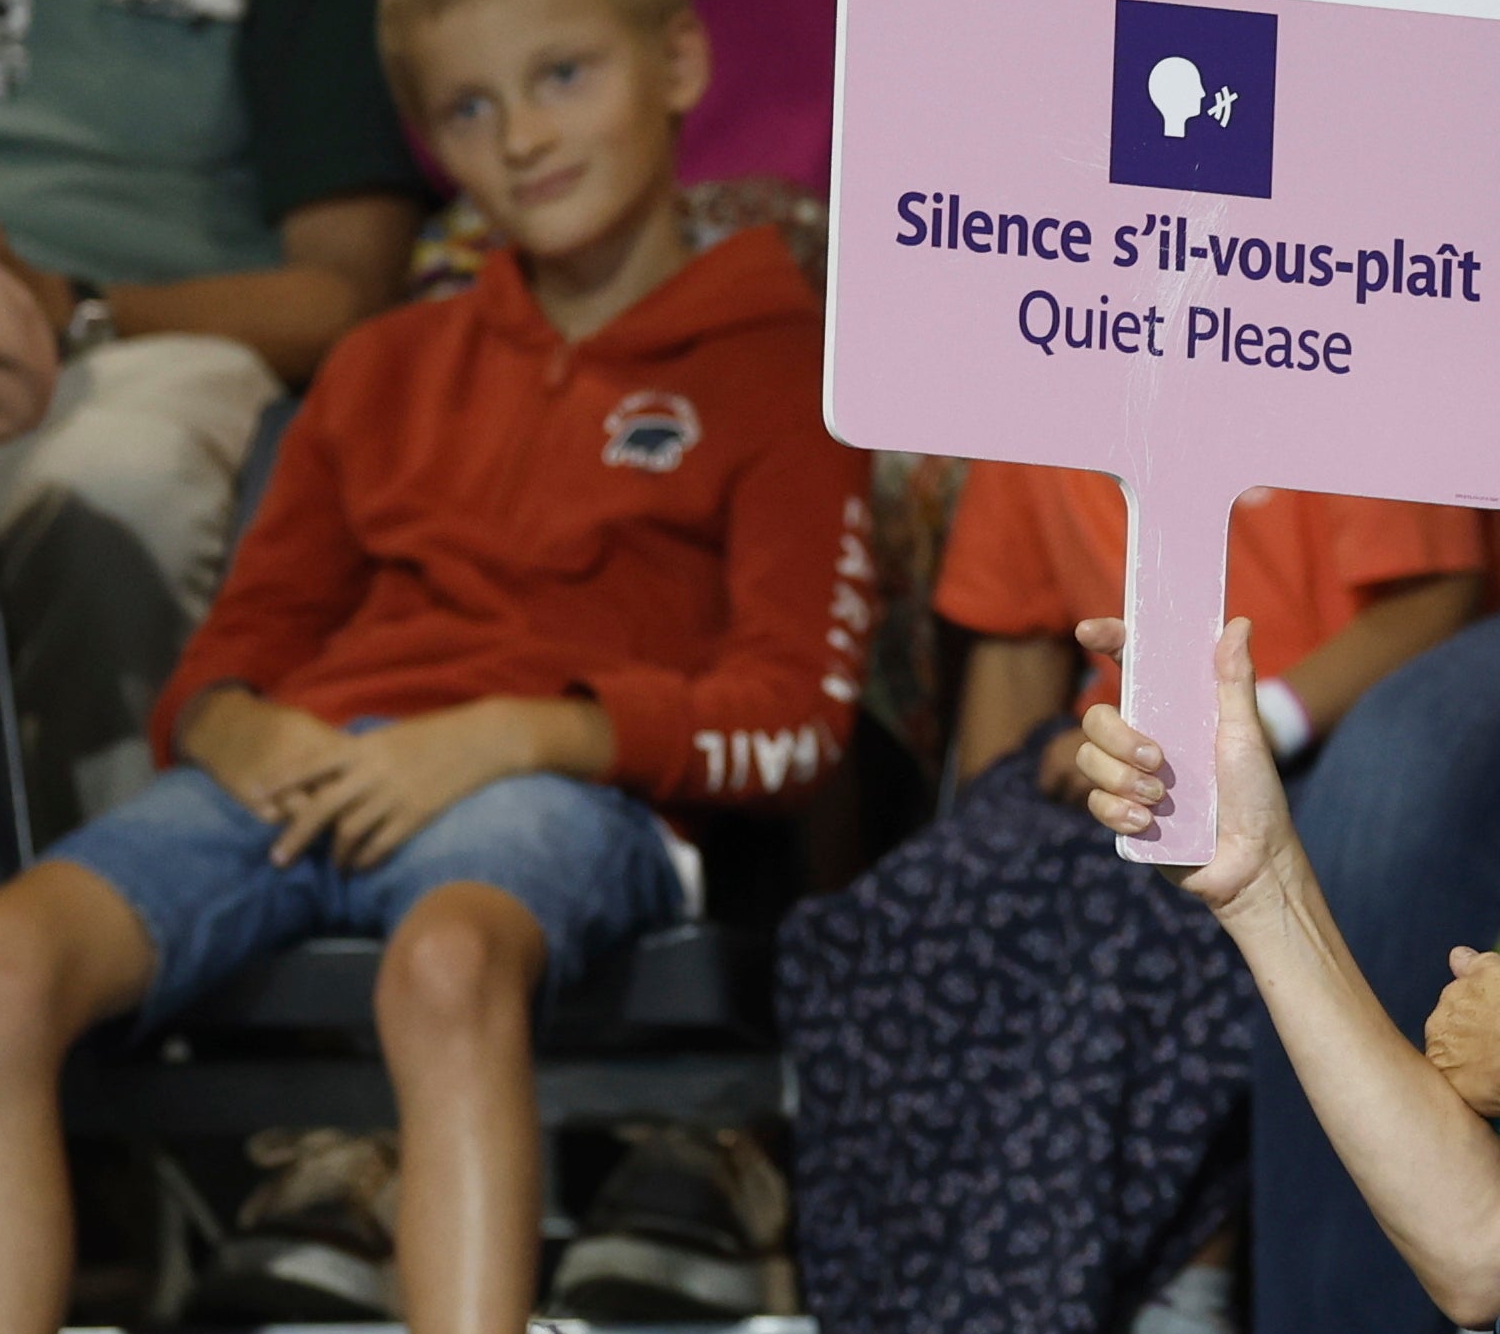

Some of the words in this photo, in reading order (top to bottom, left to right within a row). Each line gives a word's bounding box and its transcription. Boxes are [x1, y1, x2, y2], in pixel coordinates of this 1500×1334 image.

[896, 192, 1092, 262] Silence
[1113, 213, 1481, 304] s'il-vous-plaît
[1018, 290, 1165, 356] Quiet
[1186, 307, 1353, 374] Please
